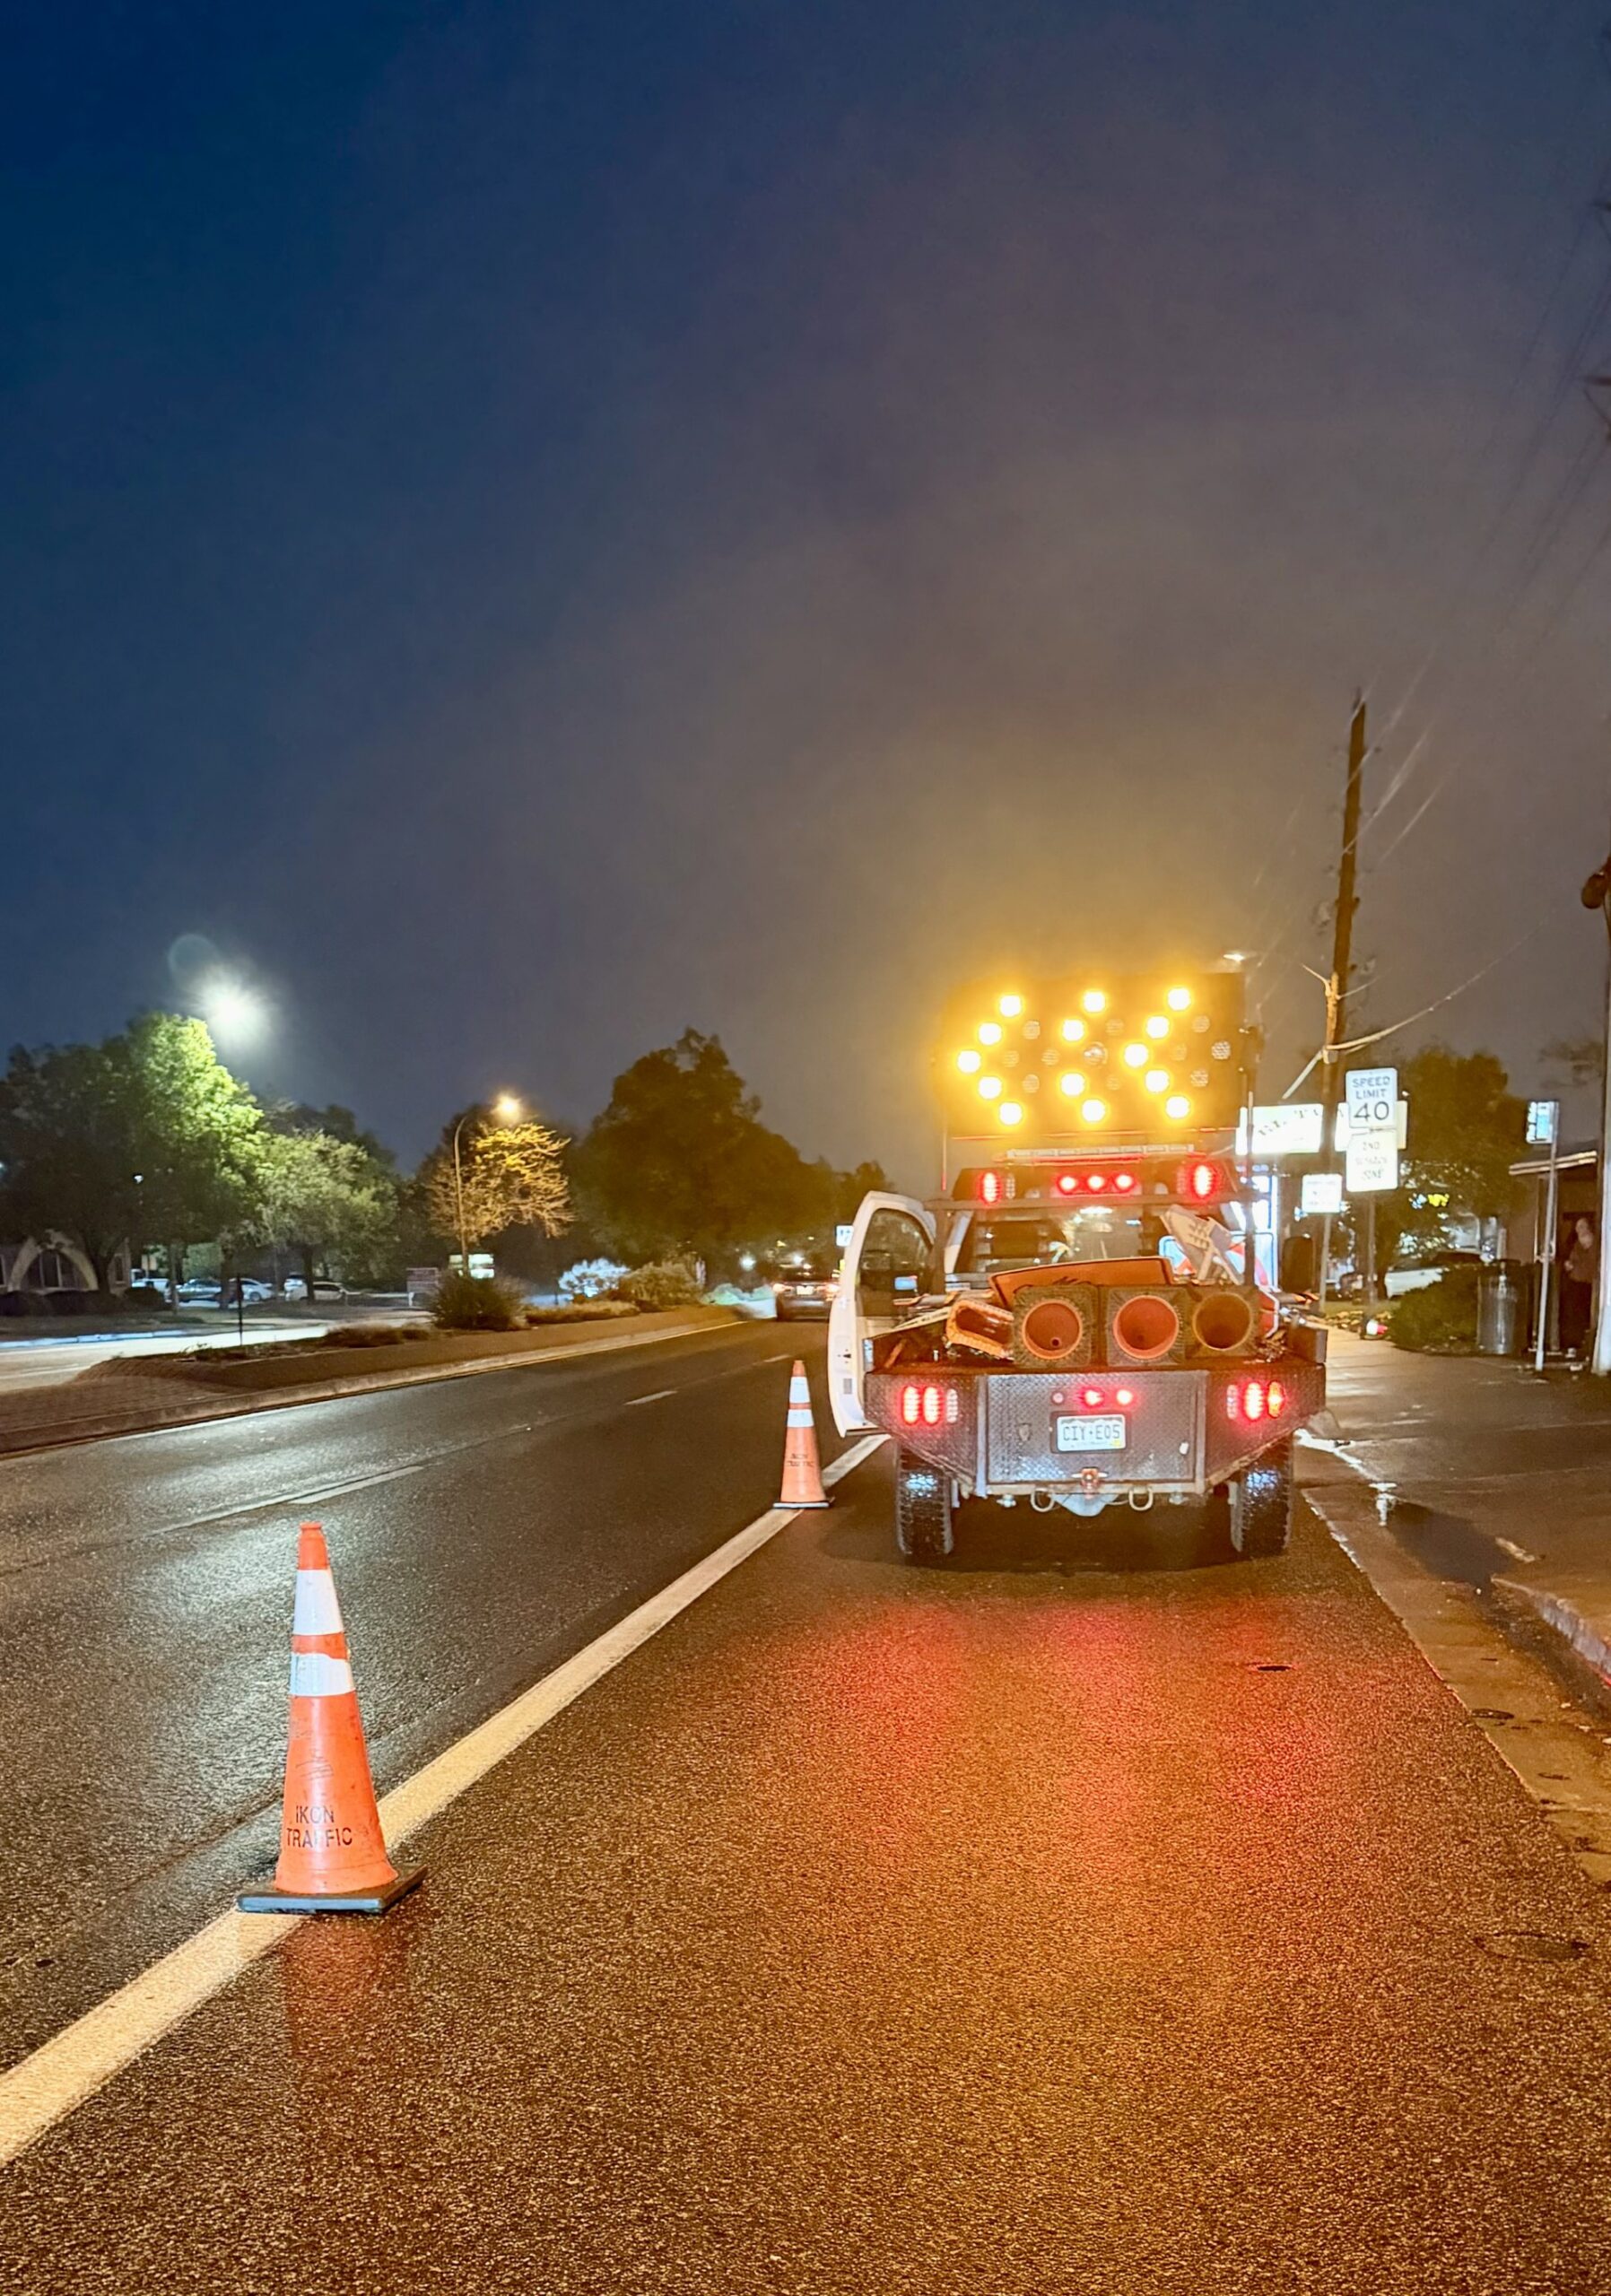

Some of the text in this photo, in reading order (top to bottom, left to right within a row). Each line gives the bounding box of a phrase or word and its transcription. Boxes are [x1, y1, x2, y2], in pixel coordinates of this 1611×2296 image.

[1352, 1075, 1390, 1089] SPEED
[1354, 1088, 1388, 1100] LIMIT
[1354, 1101, 1389, 1121] 40
[295, 1805, 335, 1824] IKON
